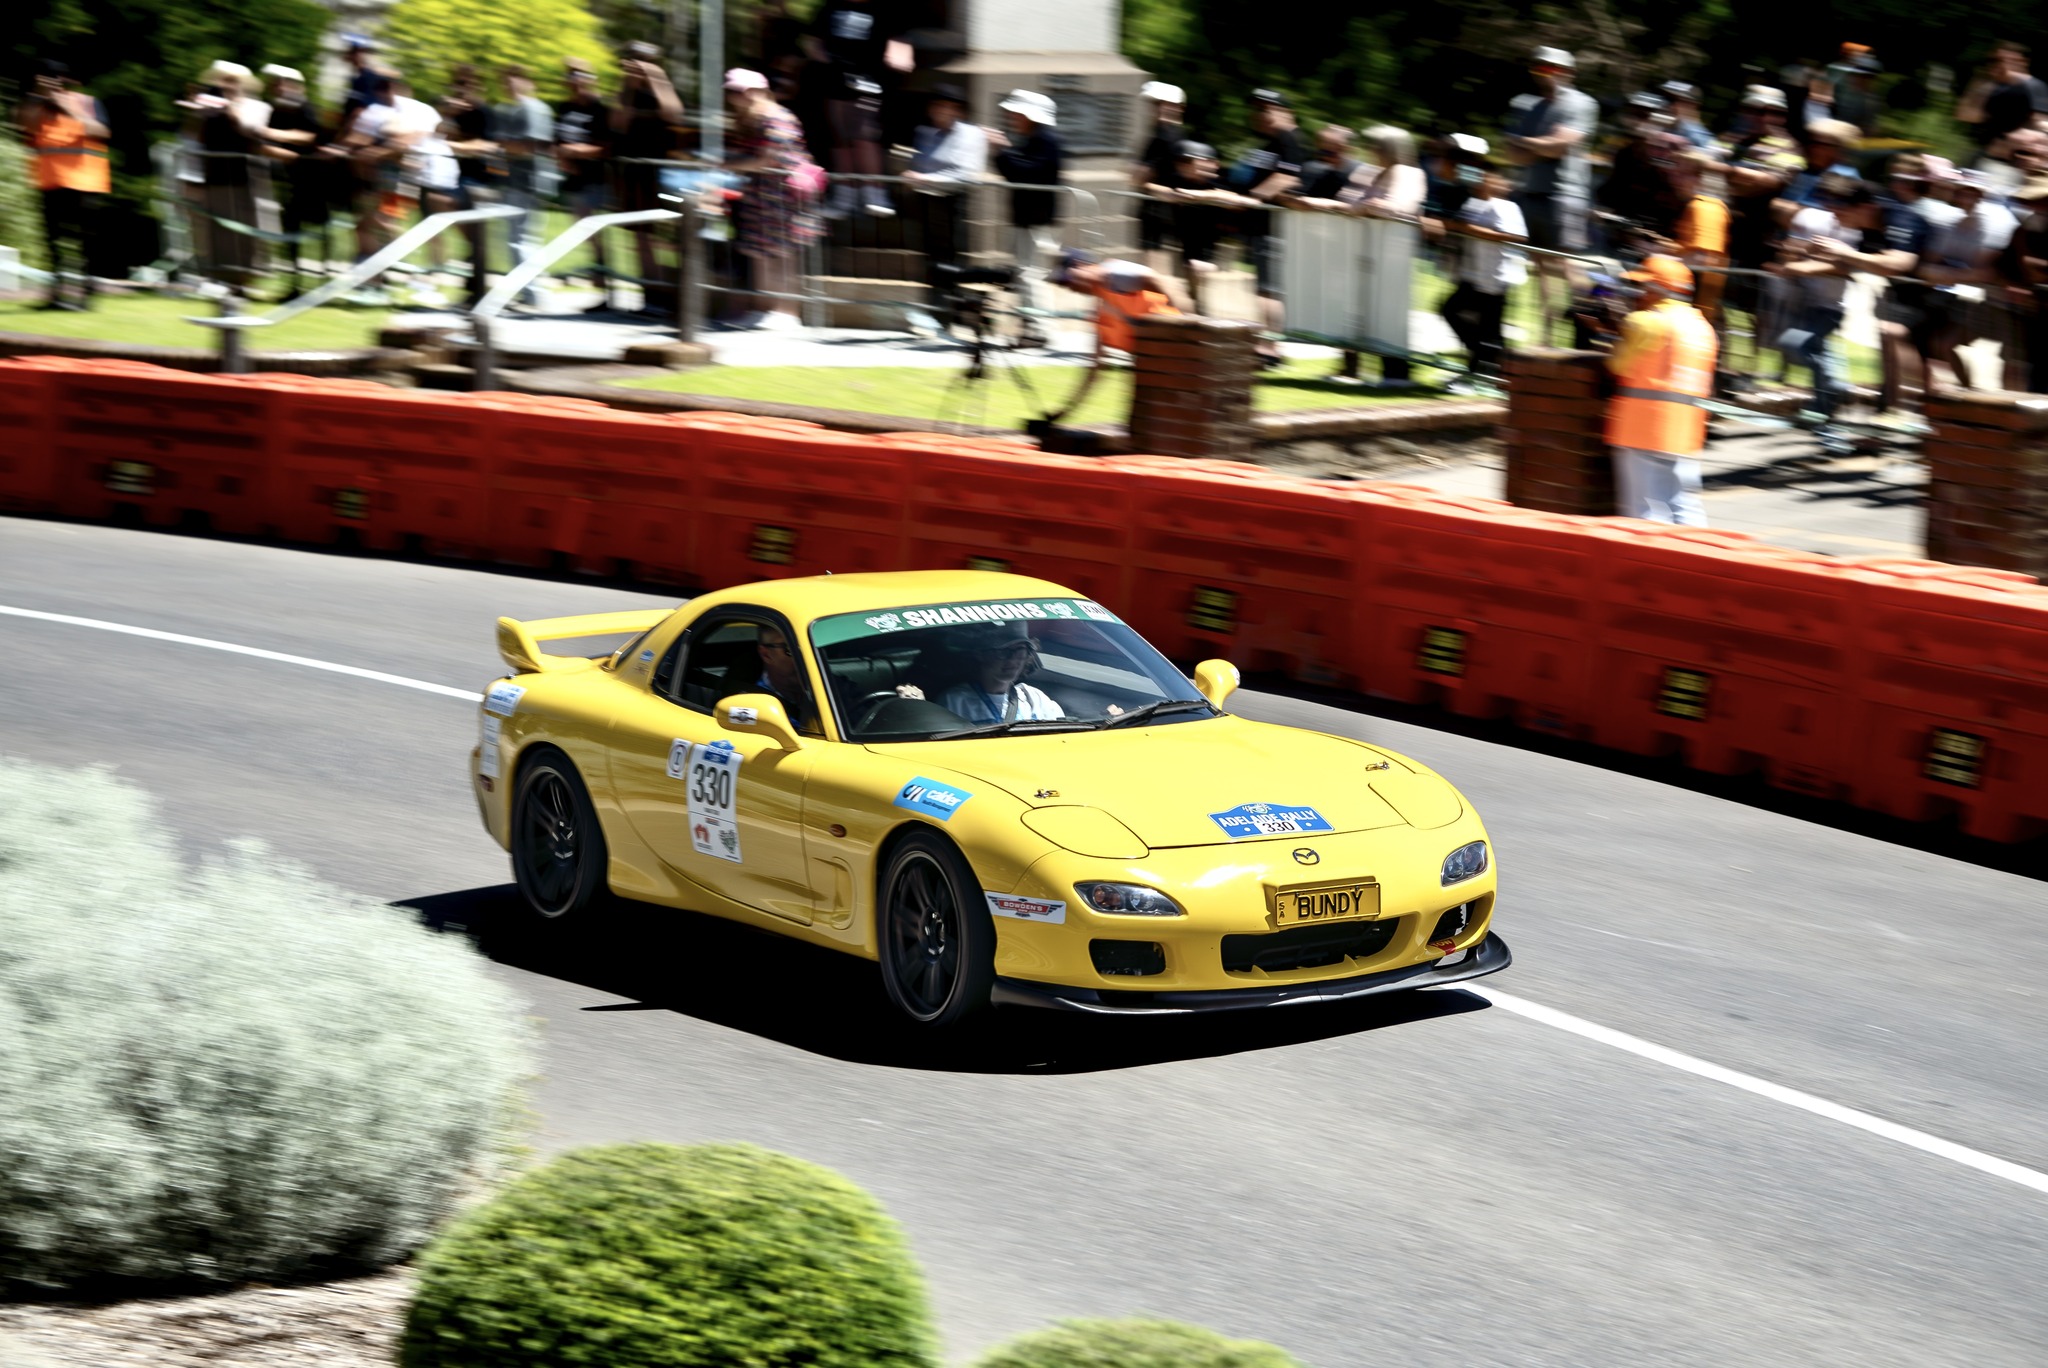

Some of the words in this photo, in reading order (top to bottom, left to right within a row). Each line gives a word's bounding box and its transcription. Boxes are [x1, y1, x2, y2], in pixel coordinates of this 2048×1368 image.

[901, 602, 1048, 627] SHANNONS
[691, 763, 730, 809] 330
[926, 789, 962, 806] calder
[1217, 812, 1281, 828] ADELAIDE
[1279, 809, 1318, 822] RALLY
[1262, 821, 1295, 832] 330
[1003, 901, 1043, 912] BOWDEN'S
[1297, 890, 1364, 919] BUNDY
